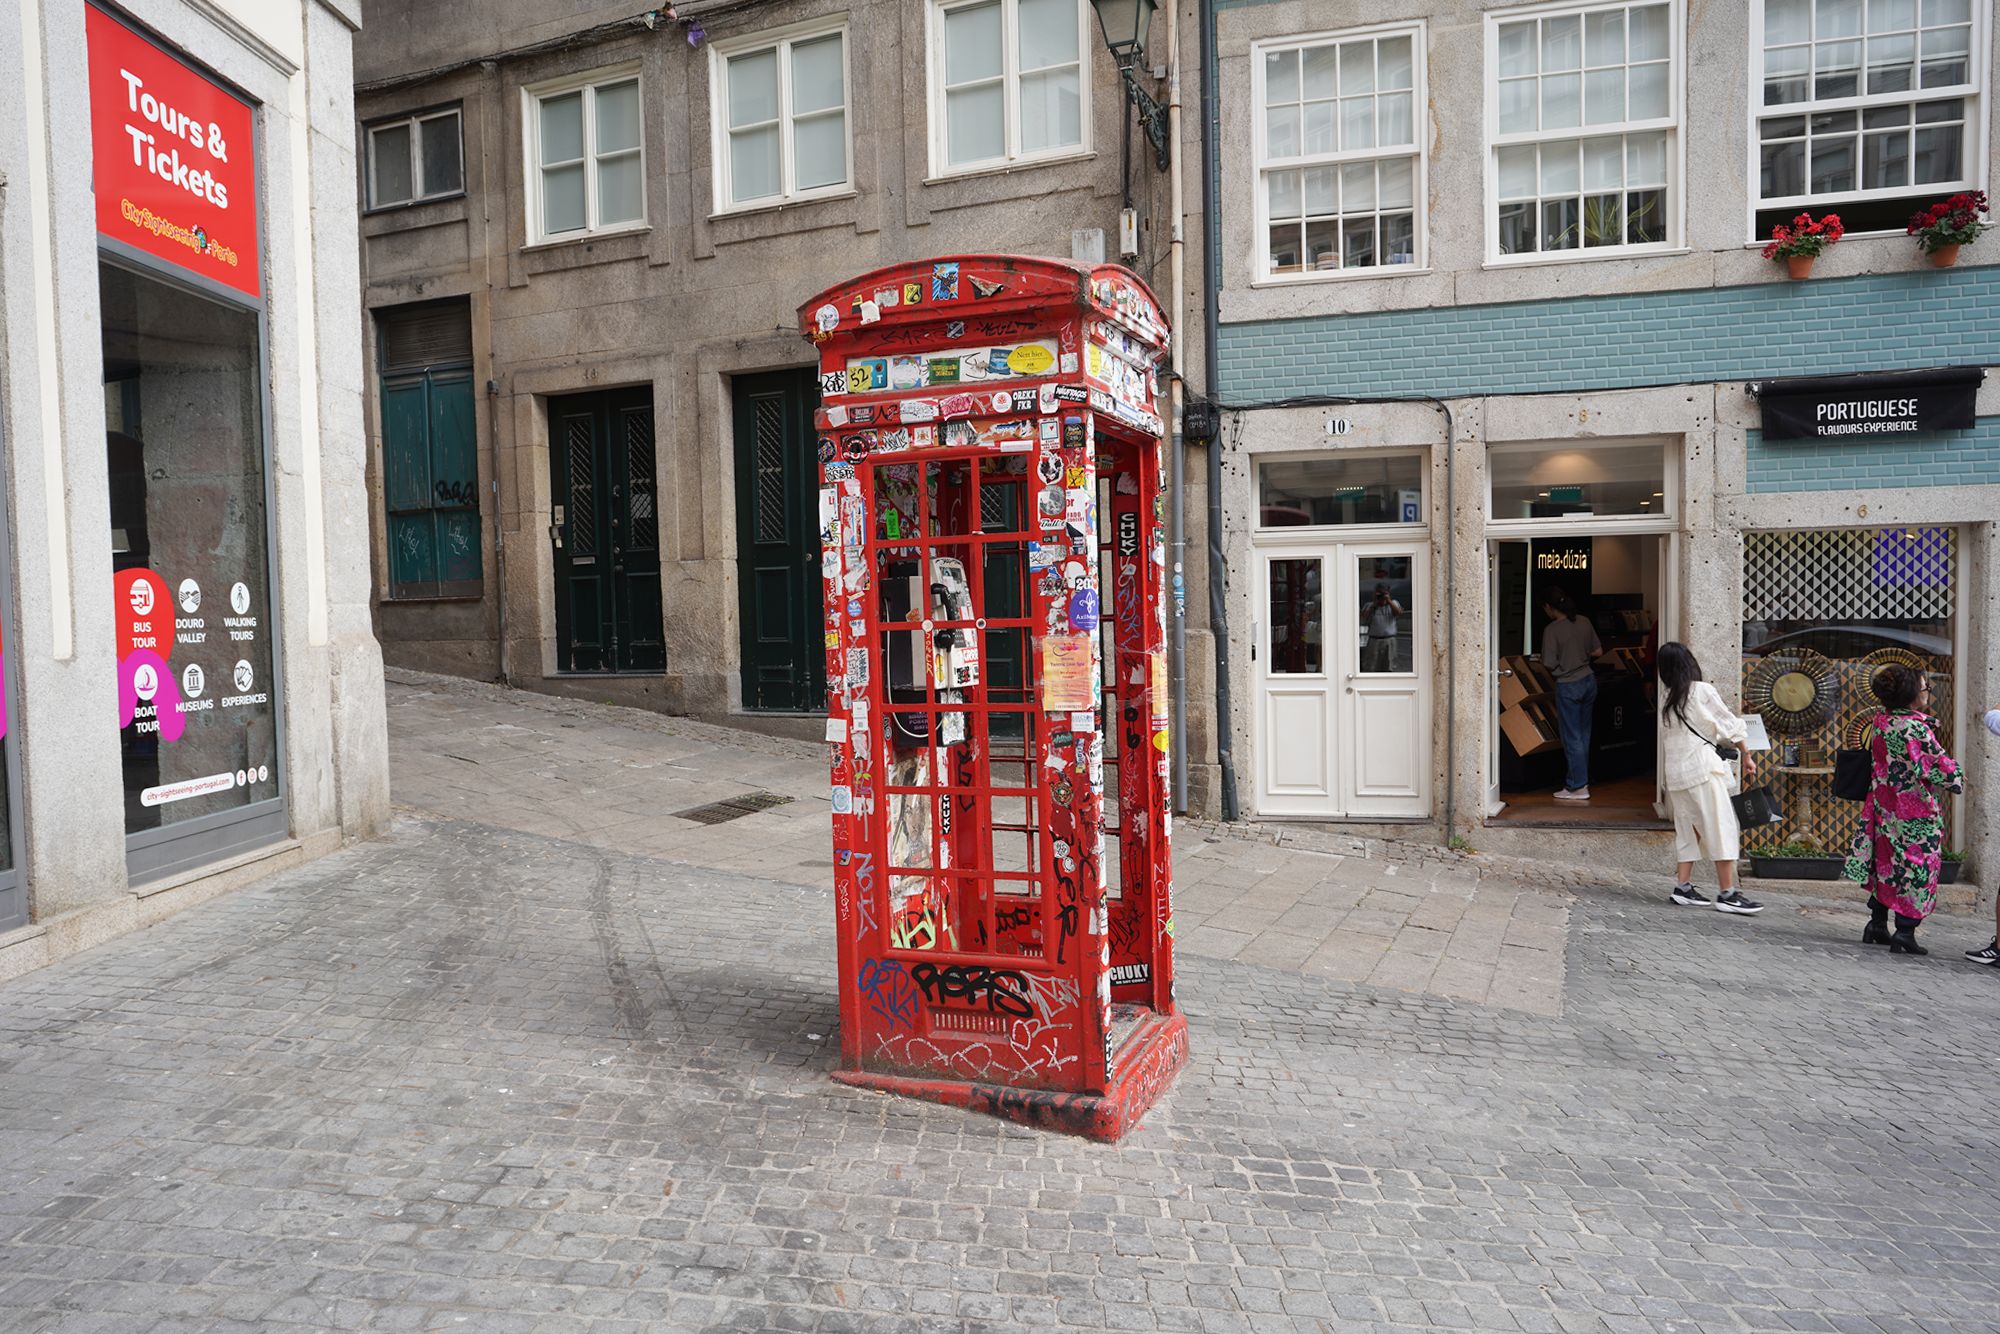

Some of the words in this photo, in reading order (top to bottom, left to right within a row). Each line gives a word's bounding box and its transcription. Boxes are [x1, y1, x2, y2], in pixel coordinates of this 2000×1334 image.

[120, 68, 205, 149] Tours
[208, 122, 228, 164] &
[125, 124, 228, 209] Tickets
[211, 239, 236, 267] Porto
[1013, 390, 1037, 400] OREKA
[1017, 400, 1032, 410] FKR
[1817, 399, 1918, 421] PORTUGUESE
[1332, 419, 1345, 434] 10
[1817, 423, 1863, 435] FLAVOURS
[1863, 421, 1918, 433] EXPERIENCE
[1857, 504, 1868, 519] 6
[1120, 513, 1136, 556] CHUKY
[133, 622, 152, 633] BUS
[175, 618, 204, 629] DOURO
[224, 617, 257, 628] WALKING
[177, 632, 206, 644] VALLEY
[230, 630, 254, 641] TOURS
[132, 637, 157, 649] TOUR
[175, 699, 213, 713] MUSEUMS
[222, 693, 267, 708] EXPERIENCES
[134, 705, 158, 719] BOAT
[135, 721, 160, 734] TOUR
[146, 778, 230, 800] city-sightseeing-portugal.com
[943, 794, 951, 834] CHUKY
[1110, 964, 1149, 981] CHUKY
